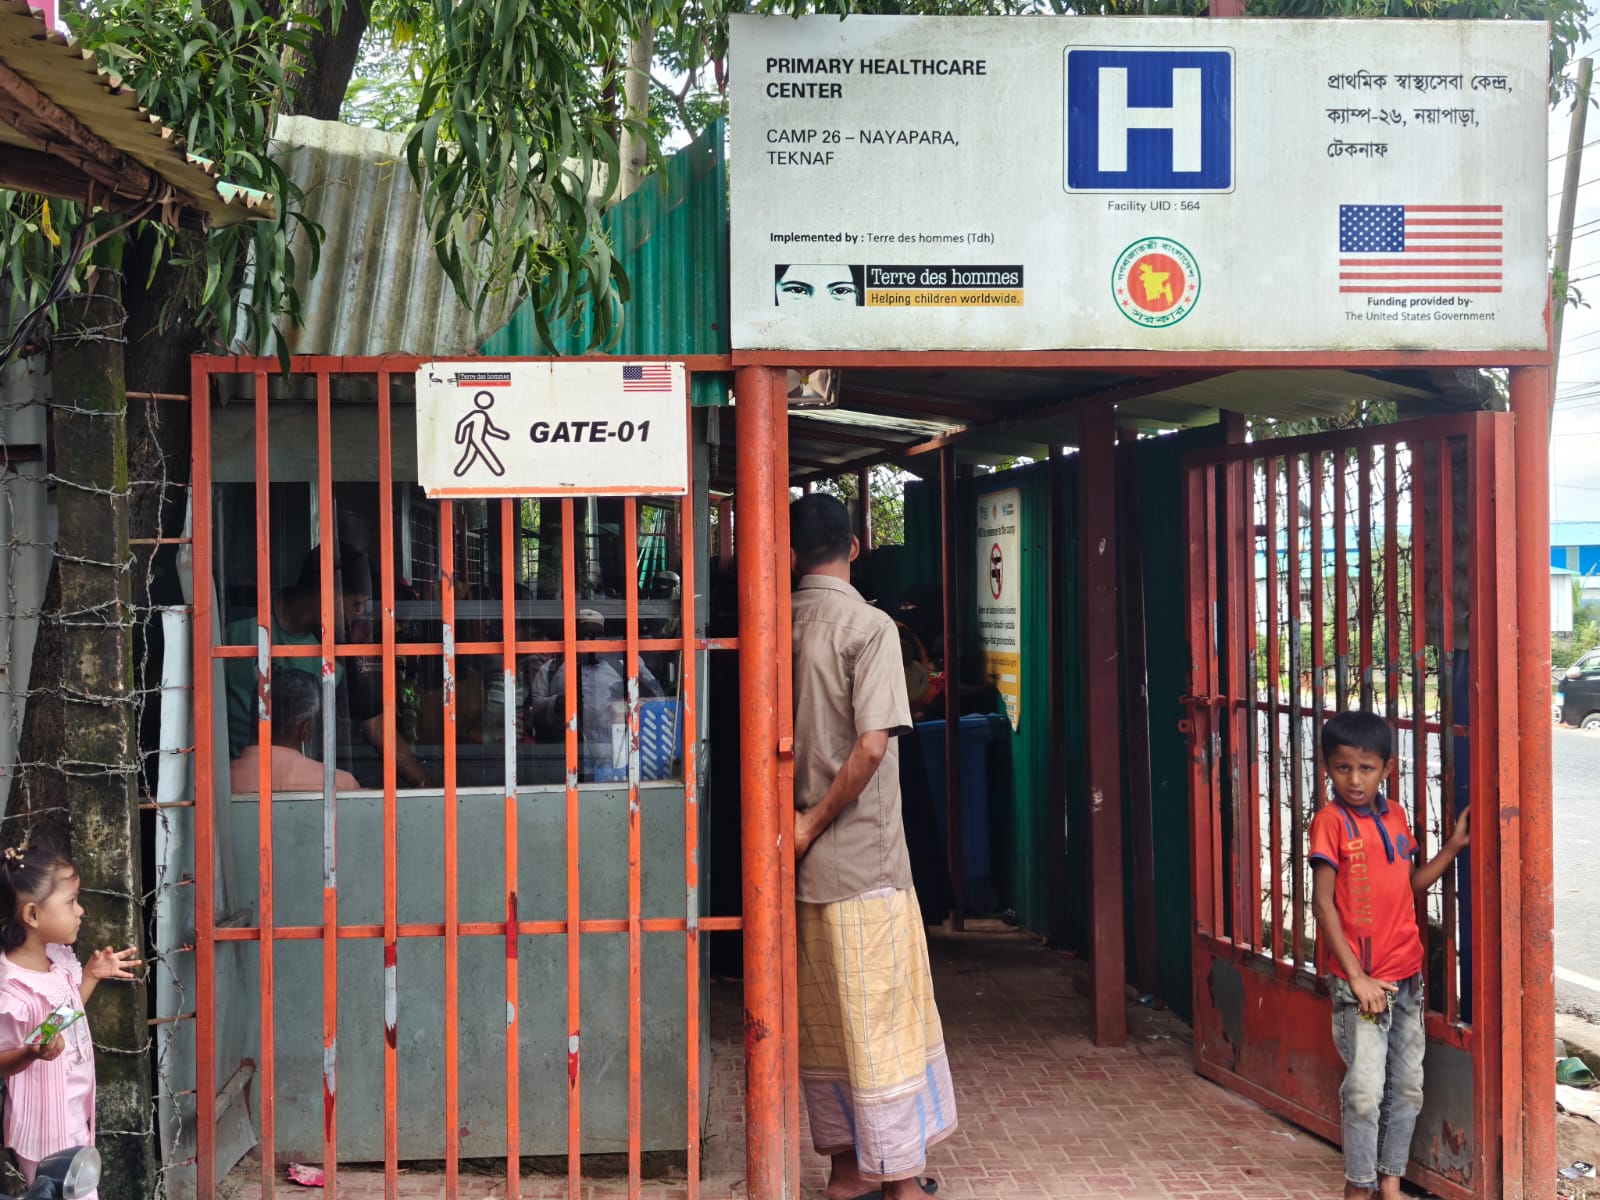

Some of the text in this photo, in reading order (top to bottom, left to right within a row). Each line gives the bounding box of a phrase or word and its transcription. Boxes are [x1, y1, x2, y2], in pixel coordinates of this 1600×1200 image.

[766, 57, 987, 76] PRIMARY HEALTHCARE
[766, 82, 842, 99] CENTER
[1327, 69, 1513, 94] প্রাথমিক স্বাস্থ্যসেবা কেন্দ্র,
[1097, 66, 1202, 173] H
[1325, 107, 1479, 128] ক্যাম্প-২৬, নয়াপাড়া,
[766, 128, 817, 143] CAMP
[822, 129, 841, 144] 26
[859, 129, 959, 147] NAYAPARA,
[1326, 137, 1388, 158] টেকনাফ
[766, 150, 834, 166] TEKNAF
[1107, 200, 1147, 213] Facility
[1150, 200, 1171, 211] UID
[1180, 200, 1201, 211] 564
[770, 231, 842, 245] Implemented
[844, 232, 858, 245] by
[866, 232, 895, 243] Terre
[897, 232, 916, 243] des
[918, 232, 964, 243] hommes
[967, 232, 995, 245] (Tdh)
[871, 268, 1019, 285] Terre des hommes
[871, 292, 1020, 306] Helping children worldwide.
[1367, 296, 1407, 308] Funding
[1409, 295, 1455, 308] provided
[1344, 311, 1496, 321] The United States Government
[529, 420, 650, 443] GATE-01
[1348, 839, 1374, 928] DECISIVE
